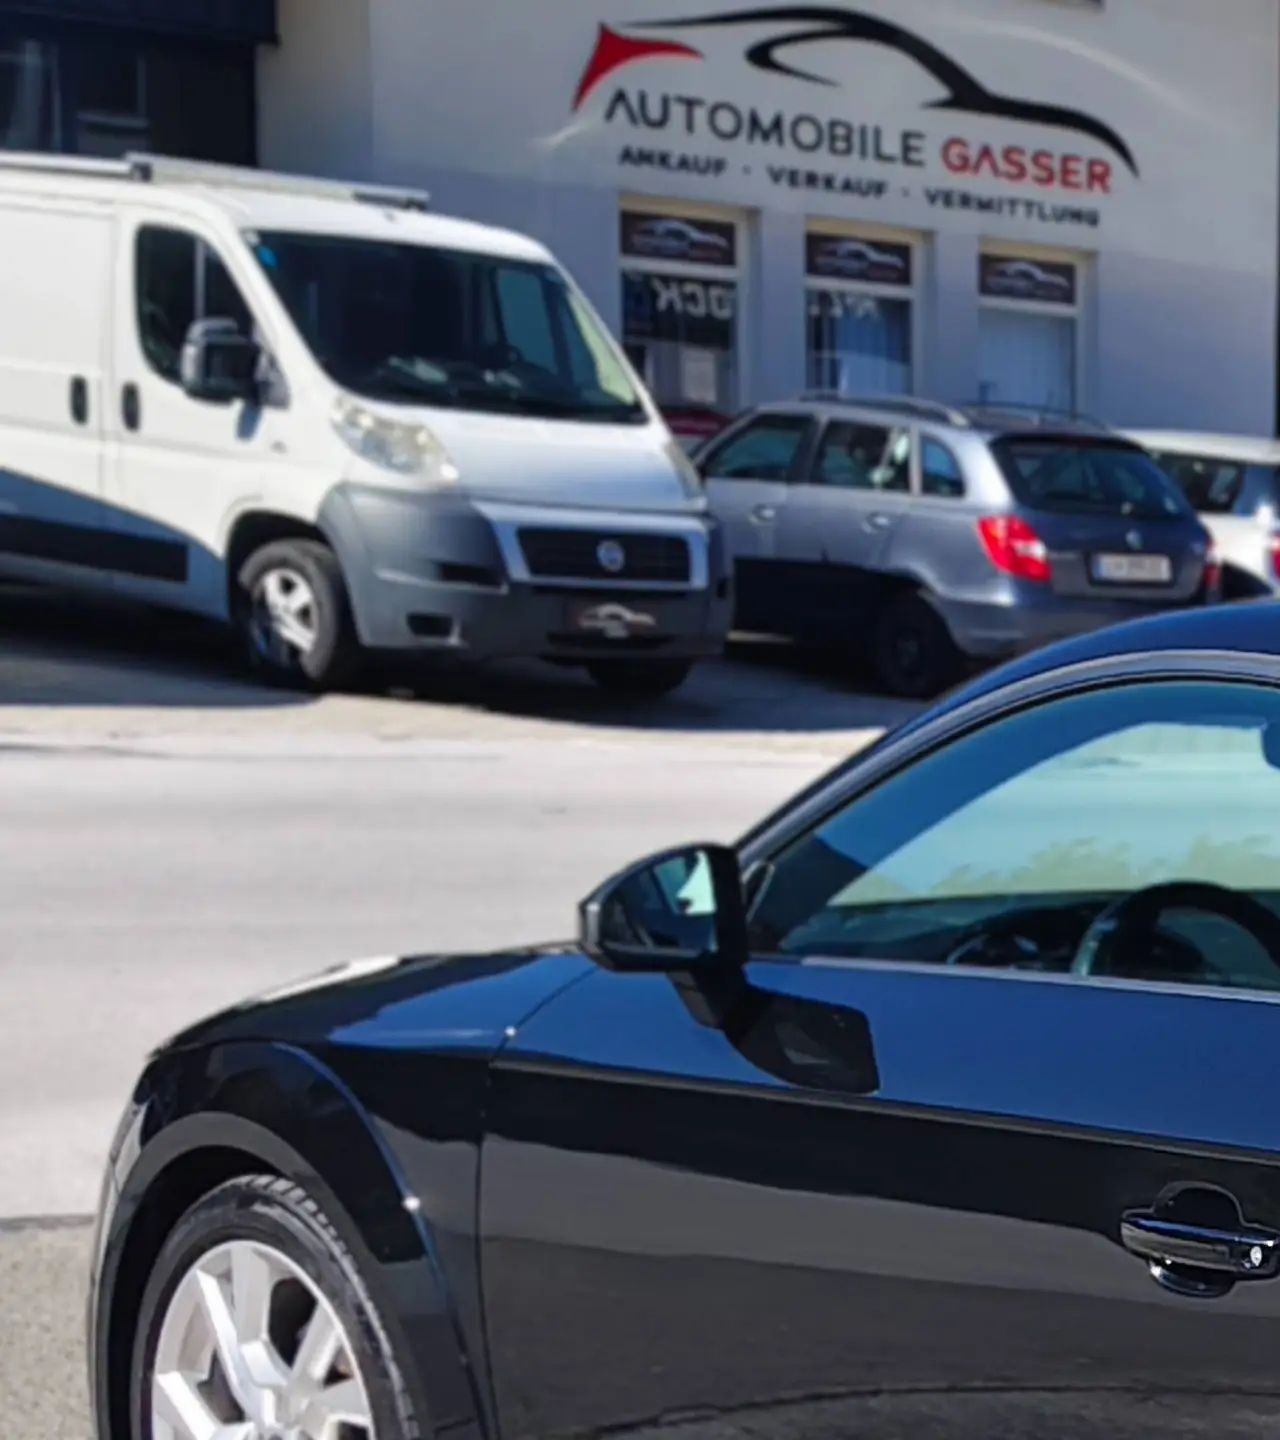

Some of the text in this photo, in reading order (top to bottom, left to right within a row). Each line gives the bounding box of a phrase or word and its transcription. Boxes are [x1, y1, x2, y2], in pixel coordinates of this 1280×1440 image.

[605, 87, 1113, 194] AUTOMOBILE GASSER
[619, 144, 1099, 227] ANKAUF VERKAUF VERMITTLUNG
